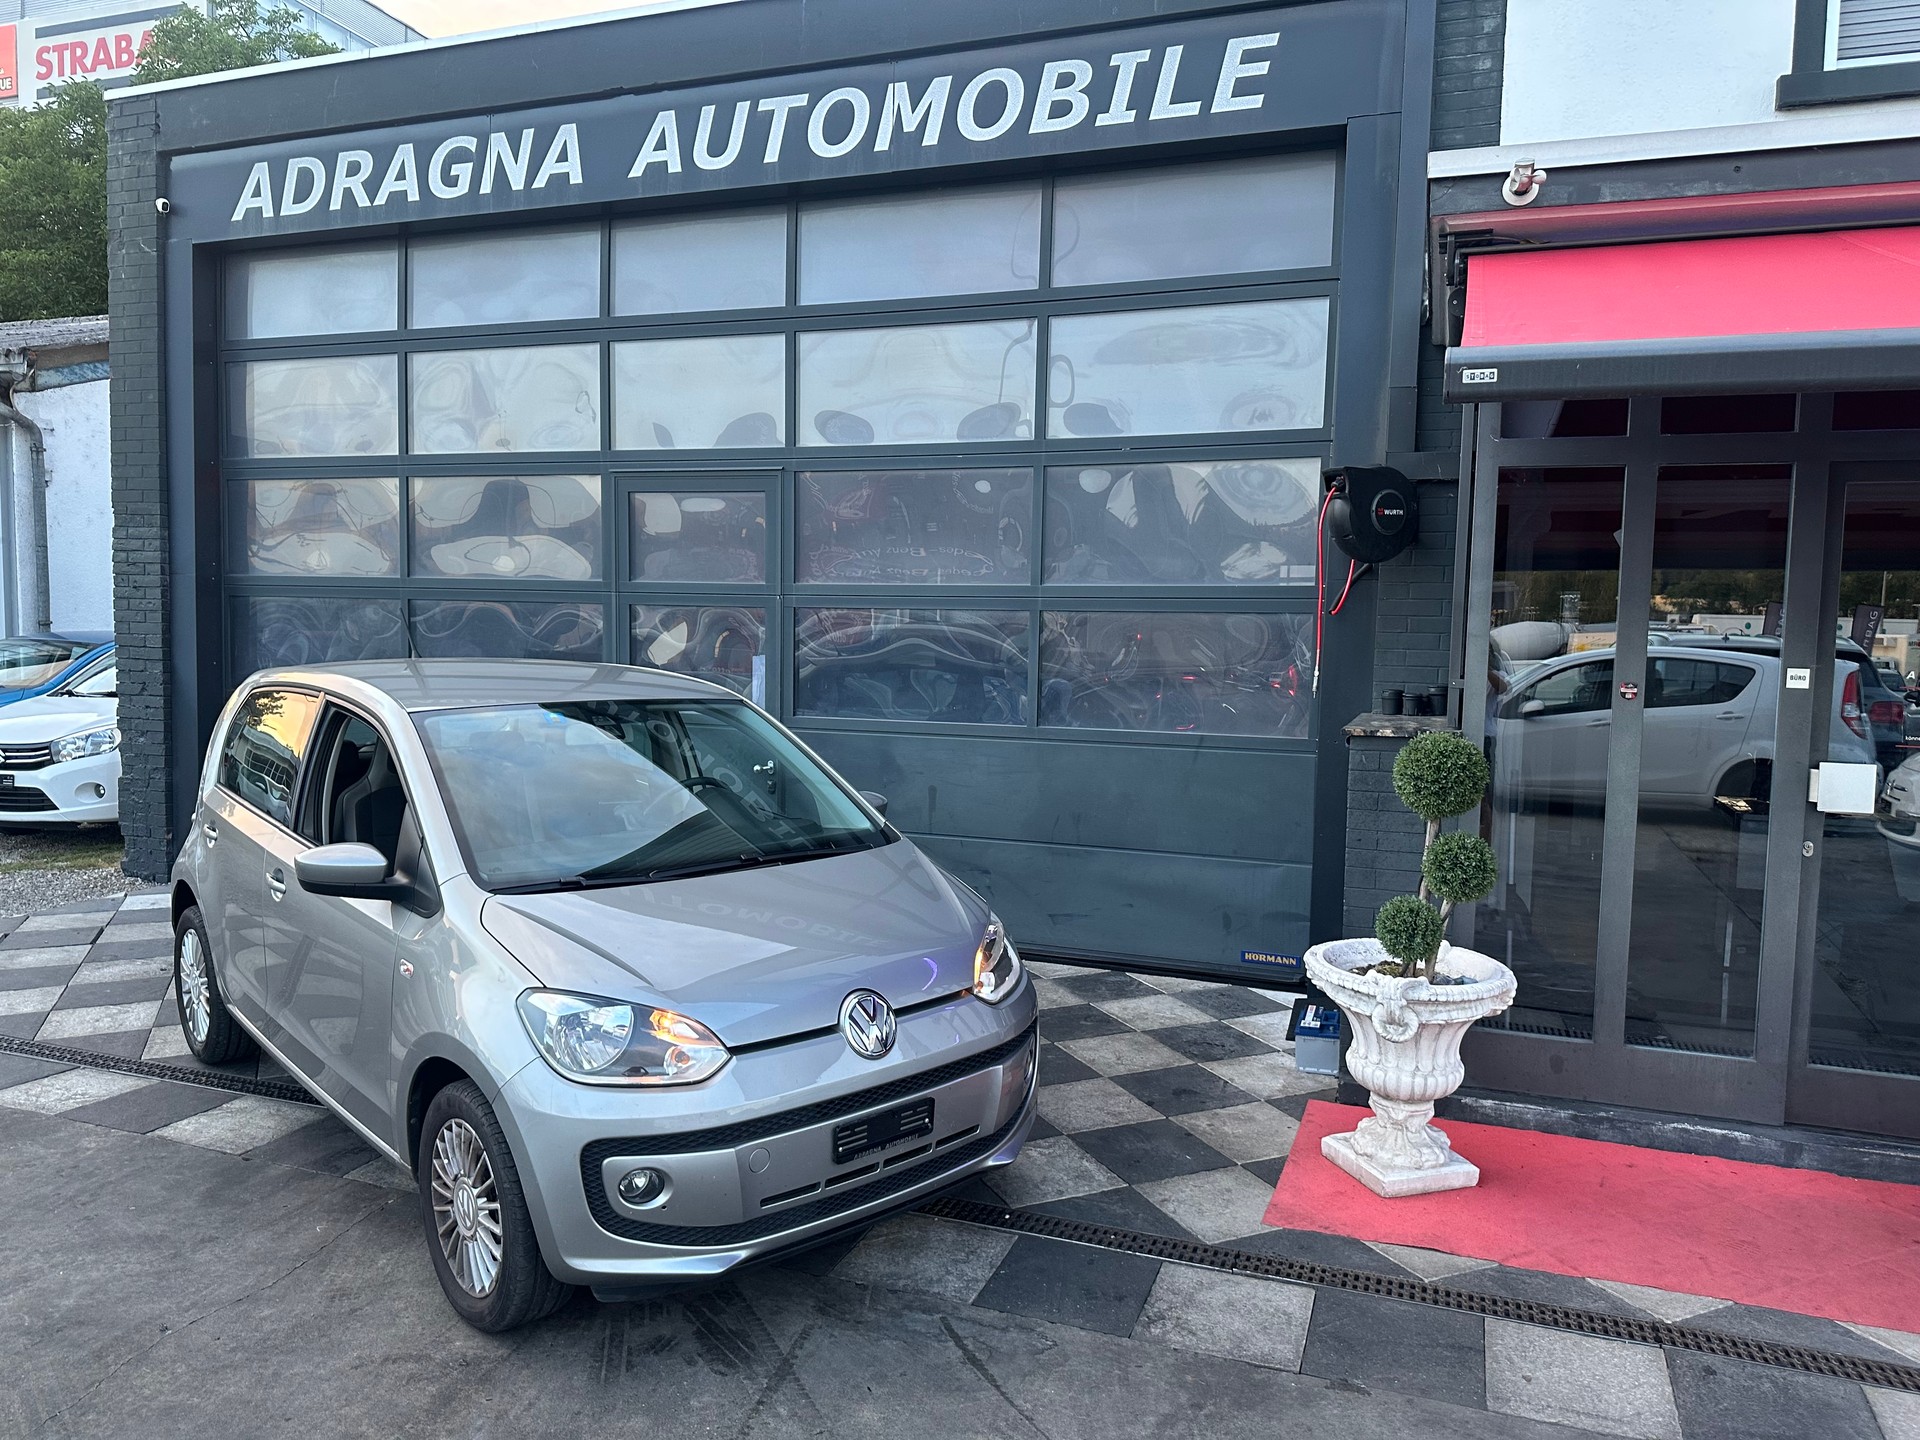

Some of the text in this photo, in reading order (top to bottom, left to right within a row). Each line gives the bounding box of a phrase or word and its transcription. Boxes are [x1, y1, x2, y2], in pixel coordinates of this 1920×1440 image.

[35, 29, 156, 81] STRABA
[230, 32, 1281, 222] ADRAGNA AUTOMOBILE
[1464, 371, 1495, 381] STOBAG
[1789, 673, 1807, 682] BÜRO
